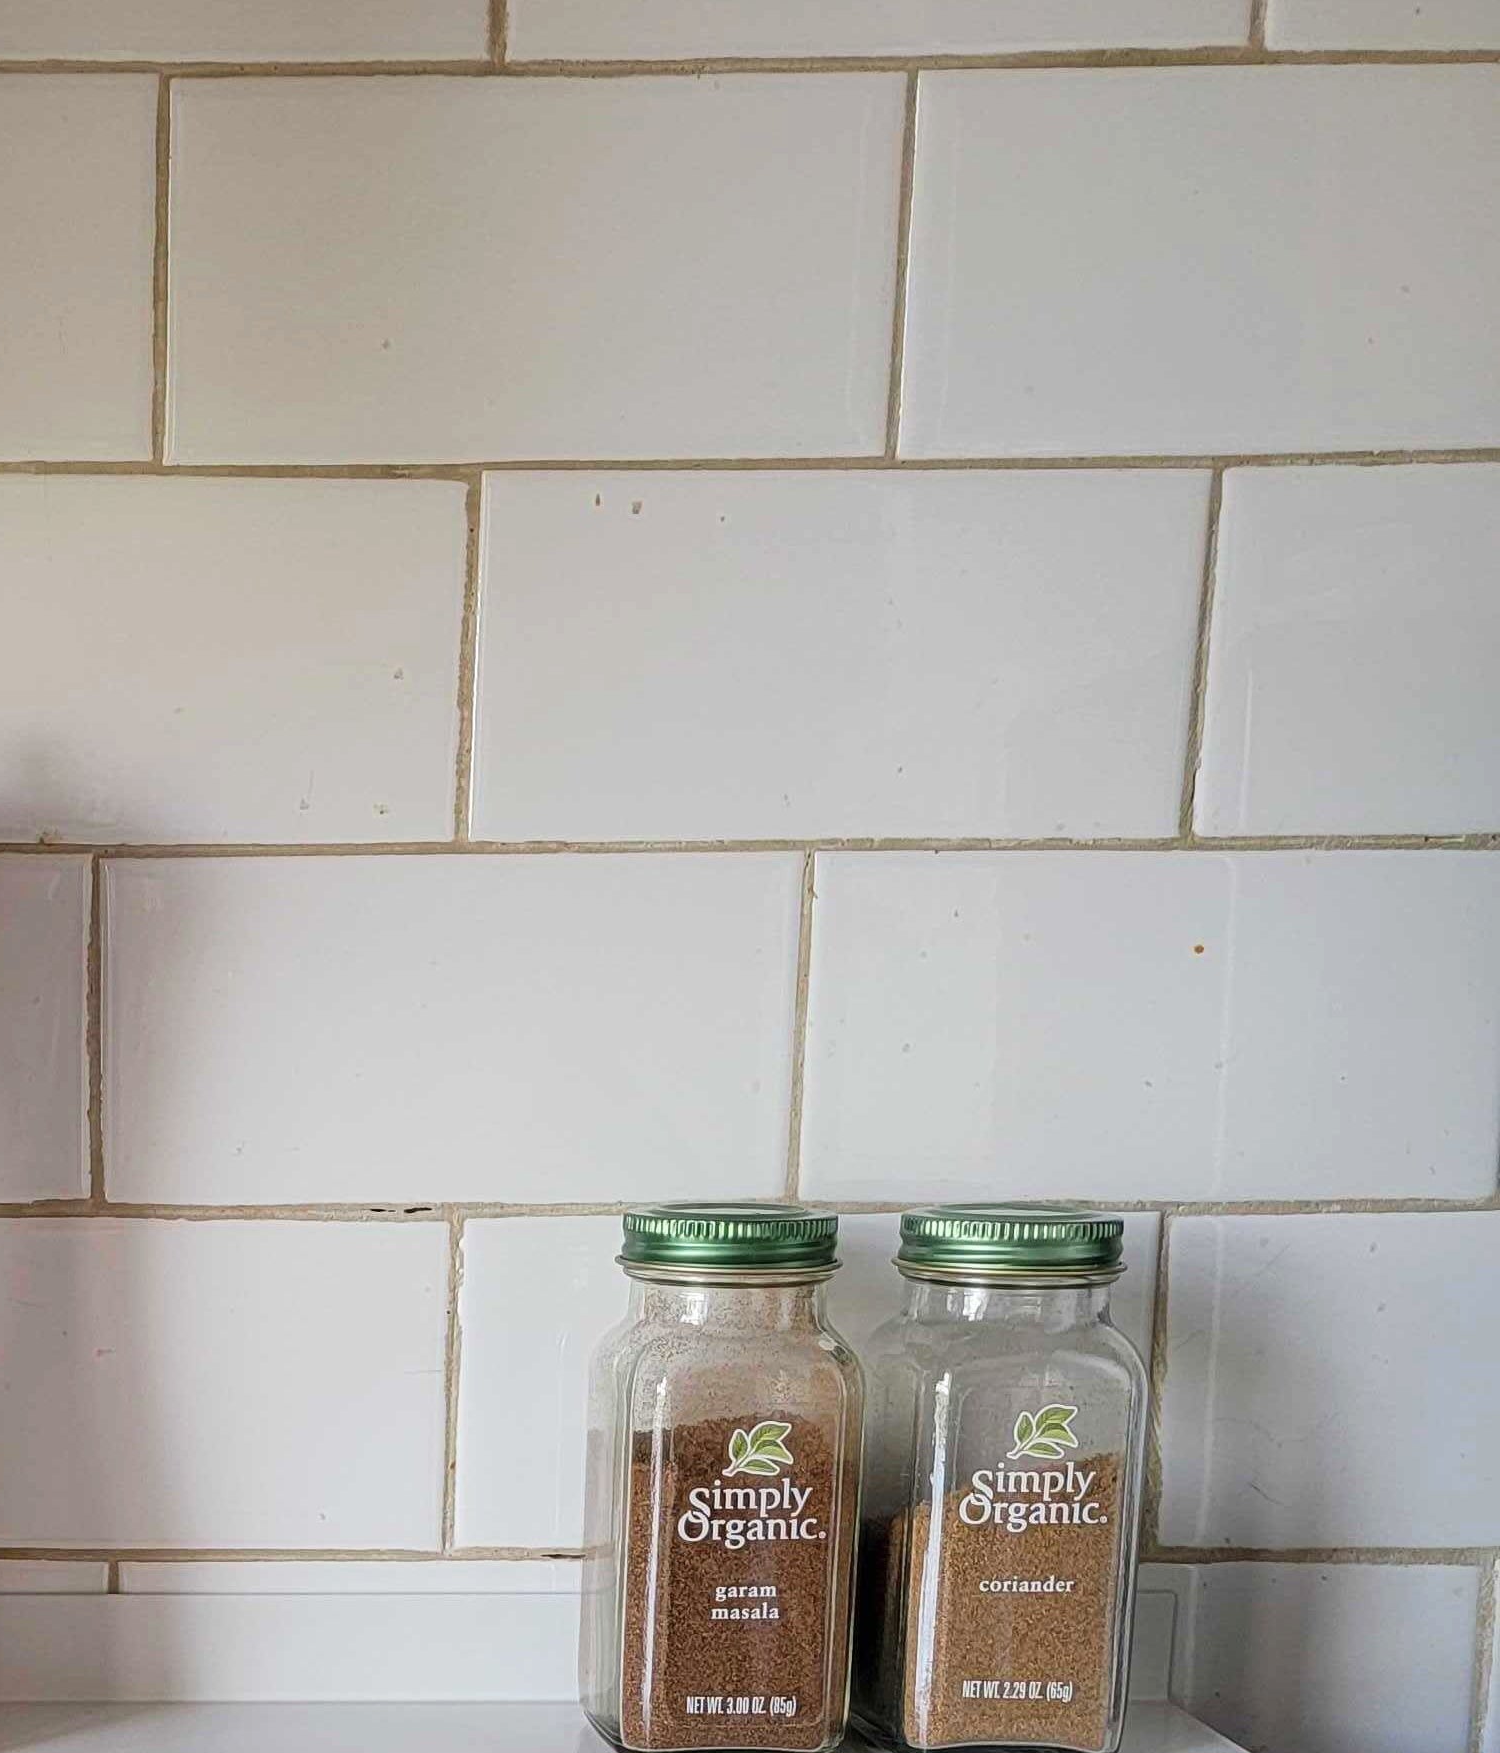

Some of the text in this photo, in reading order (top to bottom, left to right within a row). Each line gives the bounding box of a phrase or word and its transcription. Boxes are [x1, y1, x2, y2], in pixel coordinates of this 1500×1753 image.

[972, 1462, 1096, 1502] Simply
[689, 1478, 813, 1518] Simply
[715, 1585, 777, 1602] garam
[979, 1576, 1075, 1593] coriander
[711, 1602, 780, 1620] masala
[962, 1680, 982, 1698] NET
[1002, 1681, 1026, 1699] 2.29
[1046, 1681, 1073, 1703] (65g)
[686, 1696, 705, 1714] NET
[726, 1697, 749, 1714] 3.00
[769, 1695, 797, 1717] (85g)
